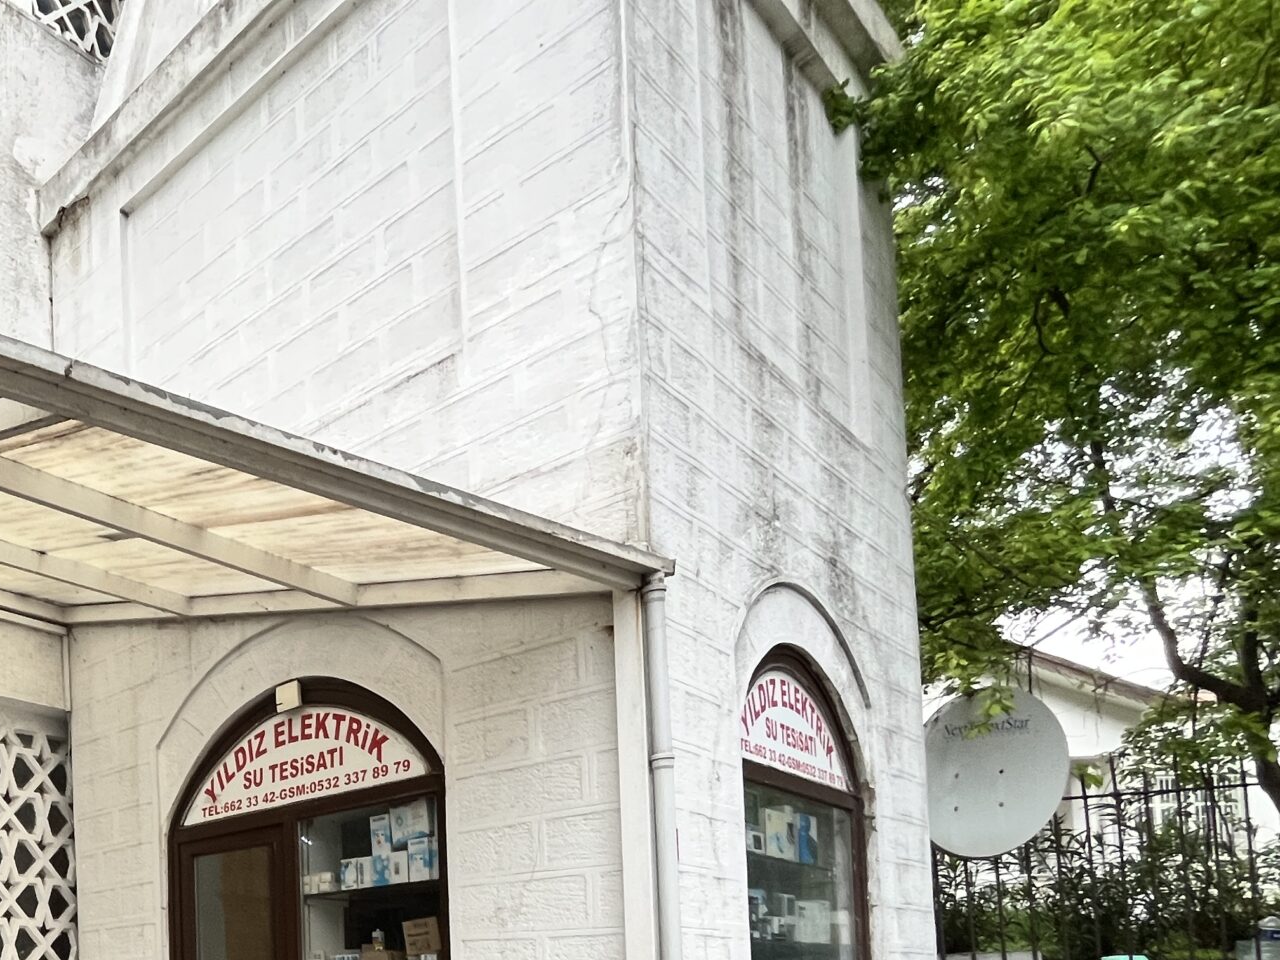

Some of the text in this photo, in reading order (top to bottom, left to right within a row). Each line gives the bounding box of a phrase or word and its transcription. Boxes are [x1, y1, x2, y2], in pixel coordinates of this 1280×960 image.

[741, 678, 778, 736] YILDIZ
[765, 717, 777, 741] SU
[204, 712, 389, 804] YILDIZ ELEKTRİK
[243, 768, 263, 789] SU
[201, 759, 410, 818] TEL:662 33 42-GSM:0532 337 89 79
